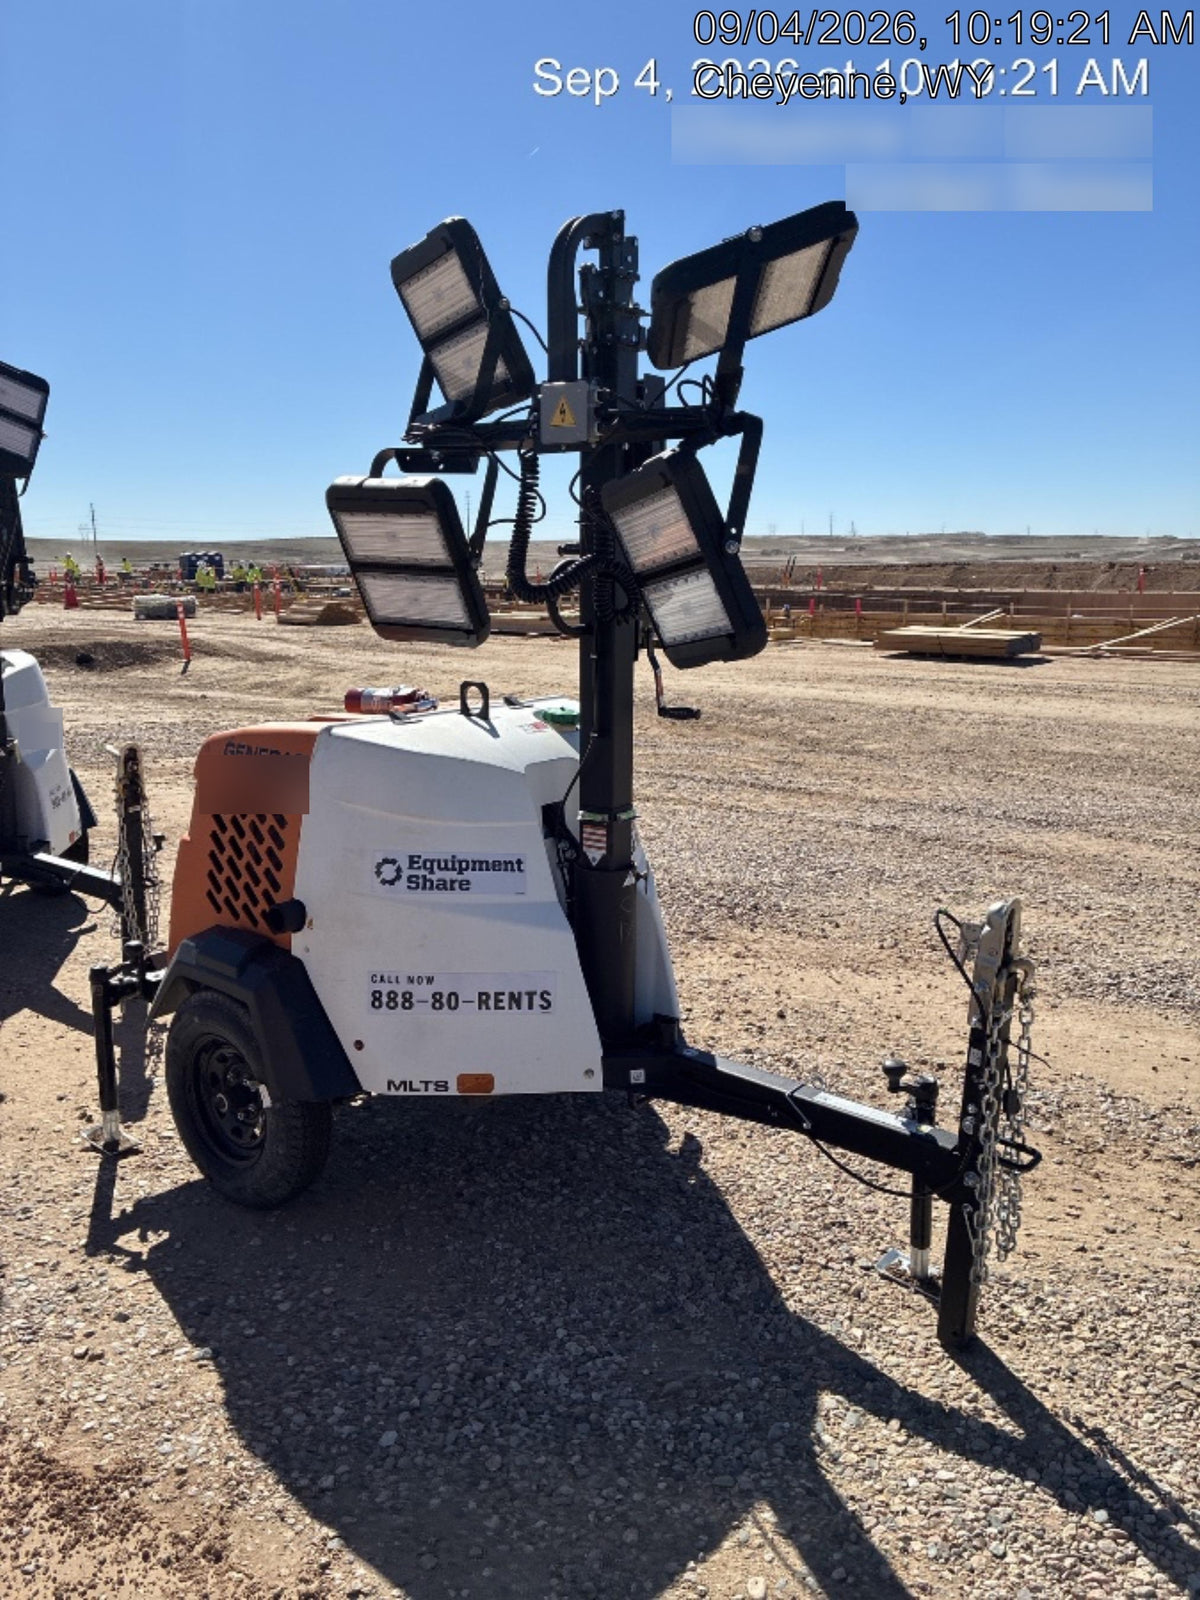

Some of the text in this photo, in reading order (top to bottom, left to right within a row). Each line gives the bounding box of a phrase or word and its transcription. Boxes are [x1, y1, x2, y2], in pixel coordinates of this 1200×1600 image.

[406, 854, 525, 875] Equipment
[406, 874, 471, 892] Share
[370, 973, 435, 986] CALL NOW
[386, 1079, 449, 1093] MLTS
